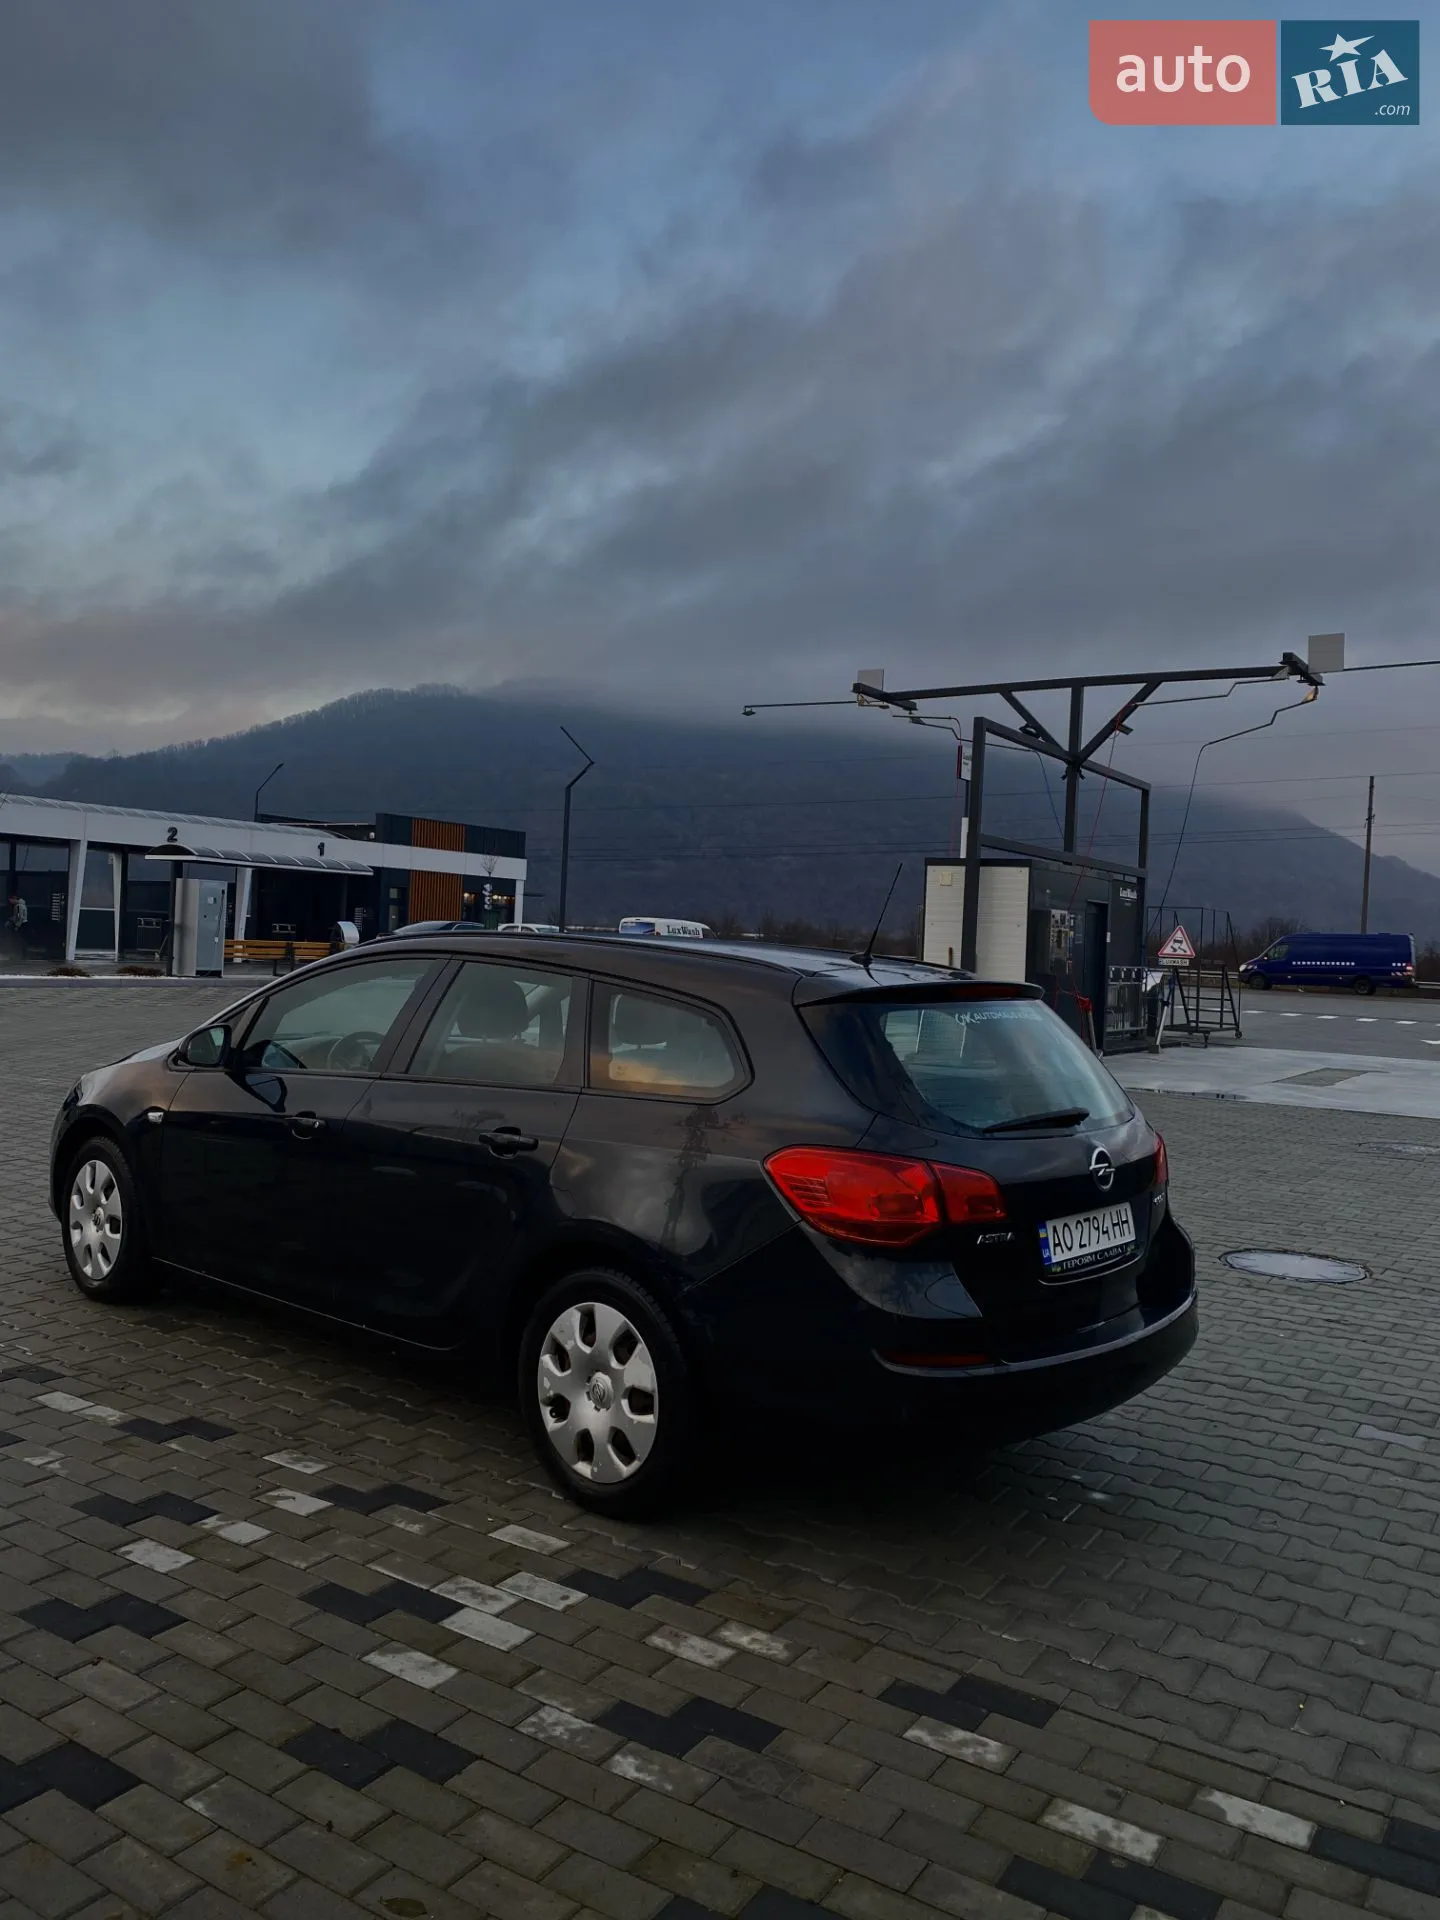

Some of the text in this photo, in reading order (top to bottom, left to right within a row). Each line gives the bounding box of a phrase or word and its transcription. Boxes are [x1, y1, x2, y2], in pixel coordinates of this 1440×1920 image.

[167, 827, 178, 842] 2
[317, 842, 326, 857] 1
[666, 924, 701, 936] LuxWash
